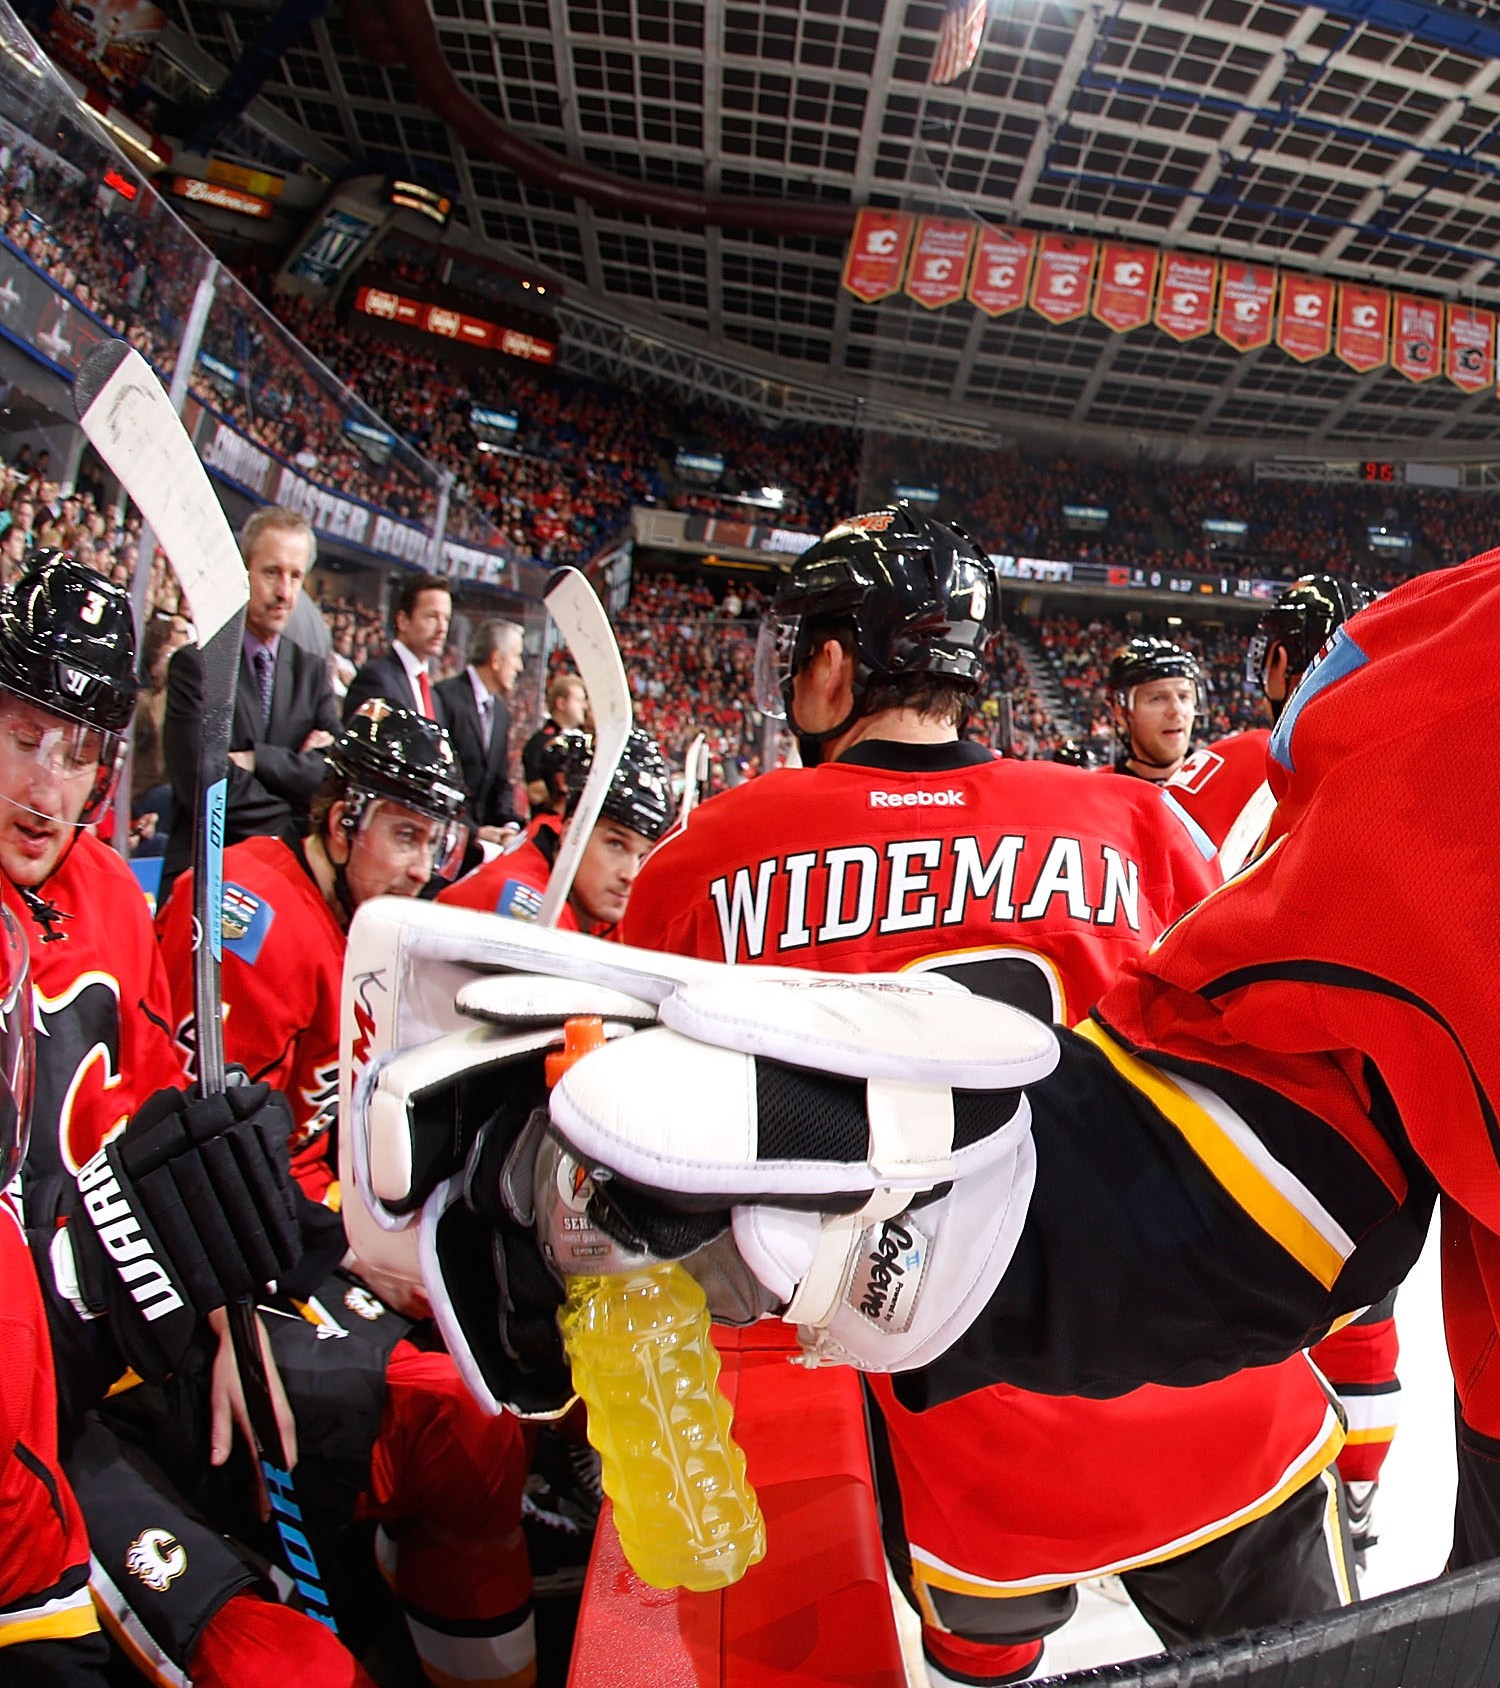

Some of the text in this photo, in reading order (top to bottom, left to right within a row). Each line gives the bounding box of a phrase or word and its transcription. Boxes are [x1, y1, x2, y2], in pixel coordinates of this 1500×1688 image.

[80, 590, 108, 625] 3
[869, 789, 966, 808] Reebok
[710, 834, 1141, 968] WIDEMAN
[563, 1216, 594, 1231] SER
